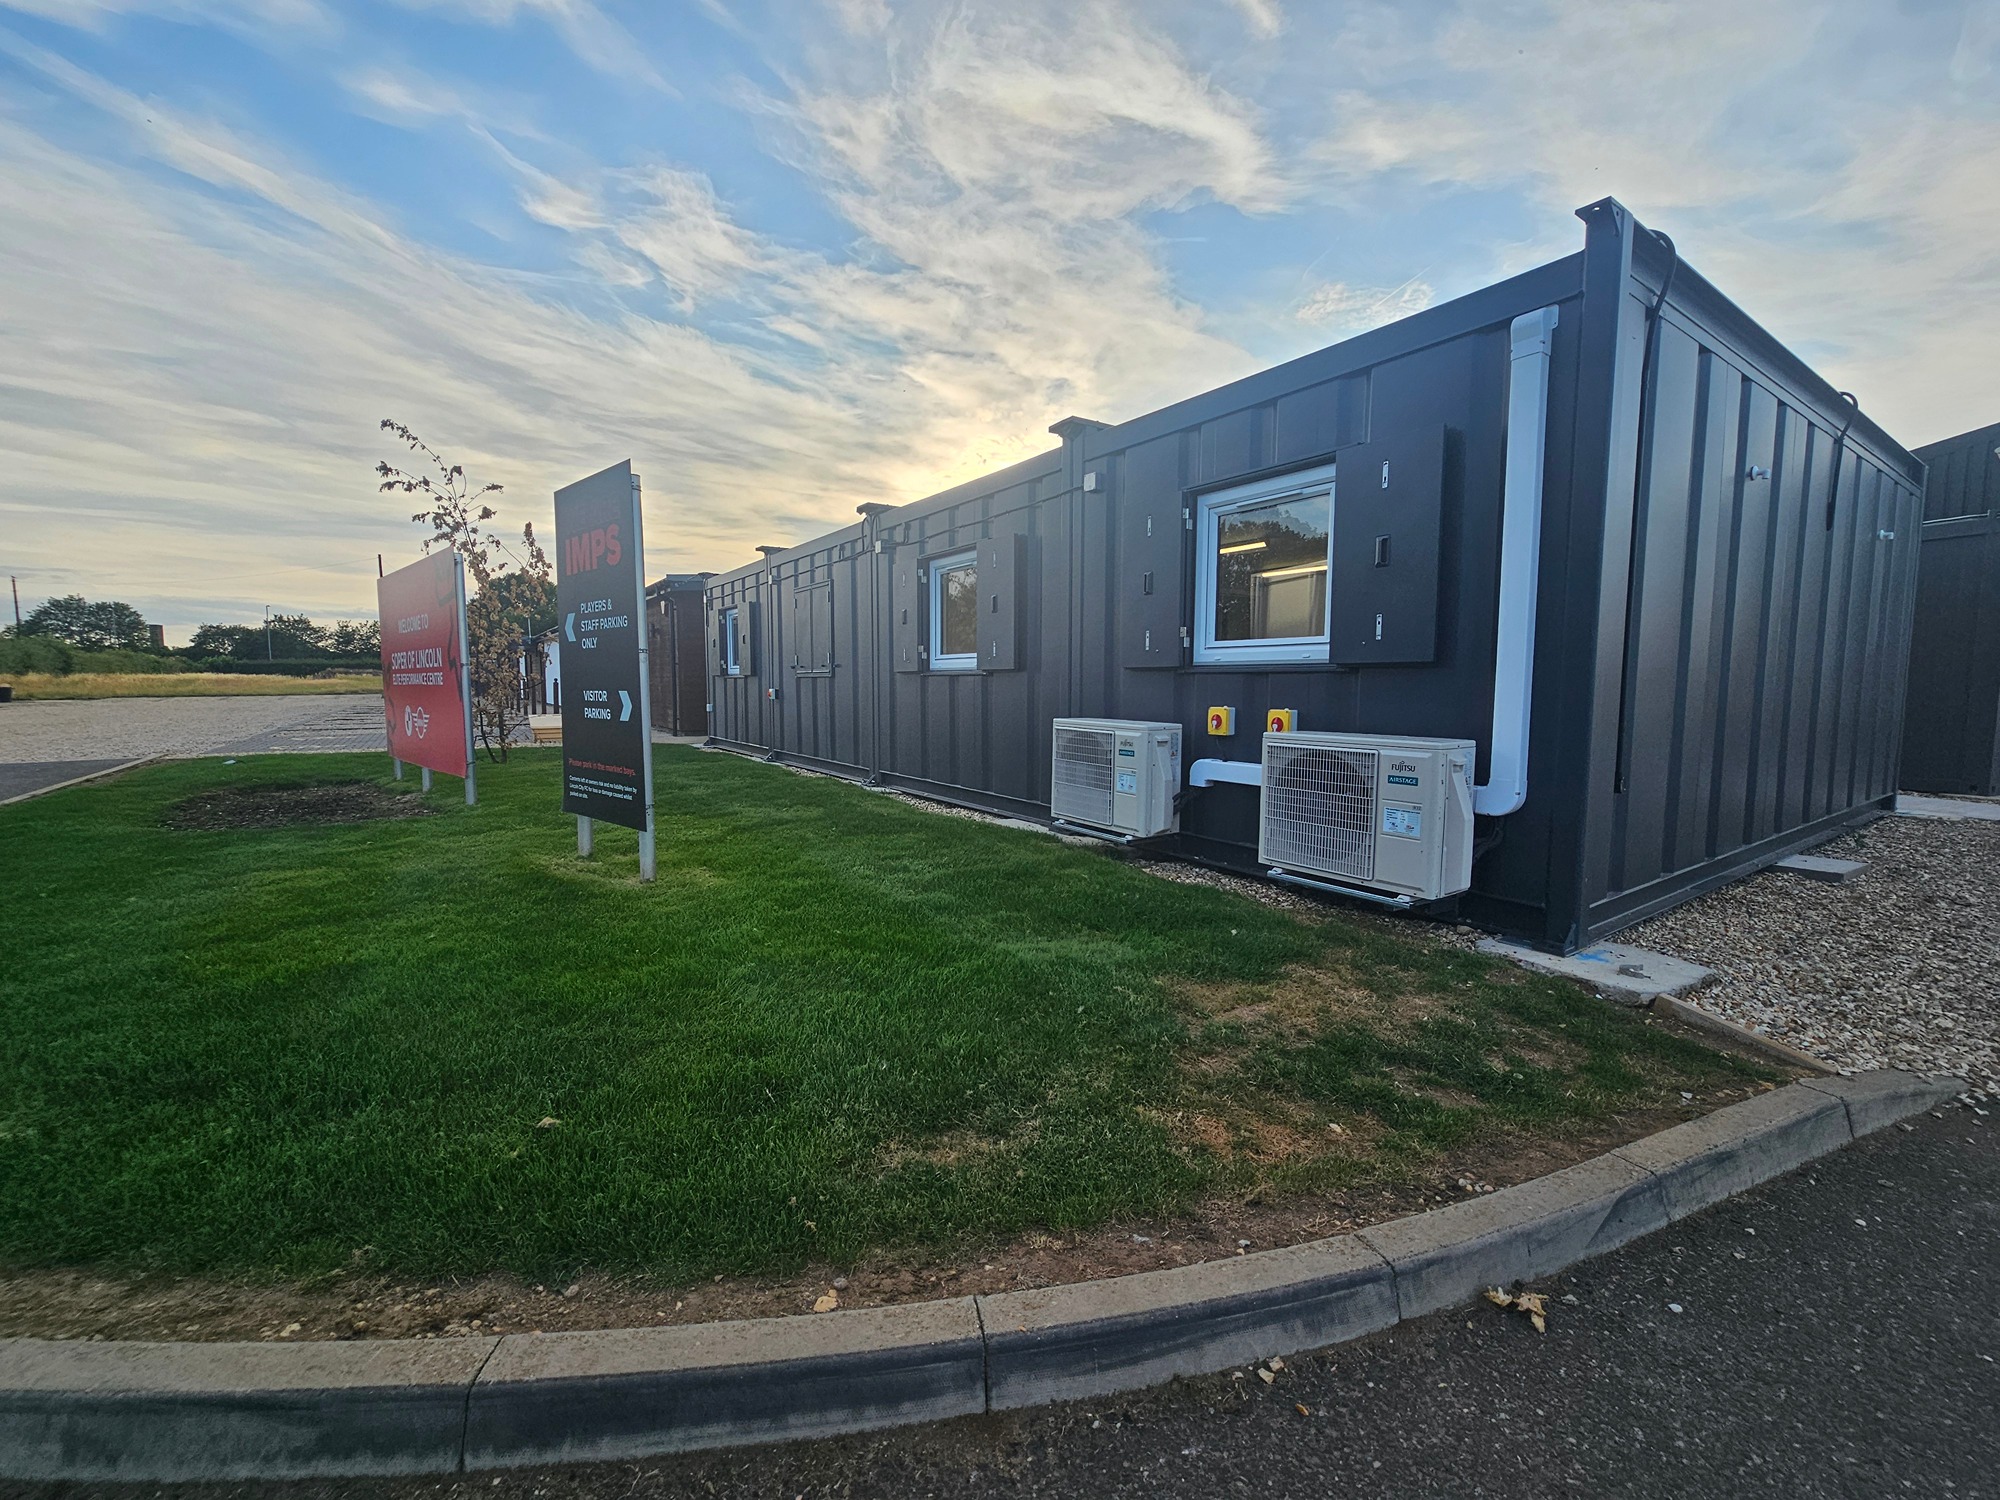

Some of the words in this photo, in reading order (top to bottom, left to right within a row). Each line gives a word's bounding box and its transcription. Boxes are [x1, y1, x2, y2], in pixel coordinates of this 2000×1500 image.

[565, 523, 621, 576] IMPS
[580, 600, 606, 614] PLAYERS
[608, 598, 612, 610] &
[398, 616, 421, 633] WELCOME
[421, 614, 428, 630] TO
[580, 619, 599, 632] STAFF
[600, 616, 628, 630] PARKING
[582, 638, 598, 649] ONLY
[392, 653, 408, 670] SOPER
[408, 651, 414, 668] OF
[416, 648, 442, 668] LINCOLN
[426, 672, 443, 685] CENTRE
[584, 690, 608, 702] VISITOR
[584, 708, 611, 720] PARKING
[1391, 760, 1416, 772] FUJITSU
